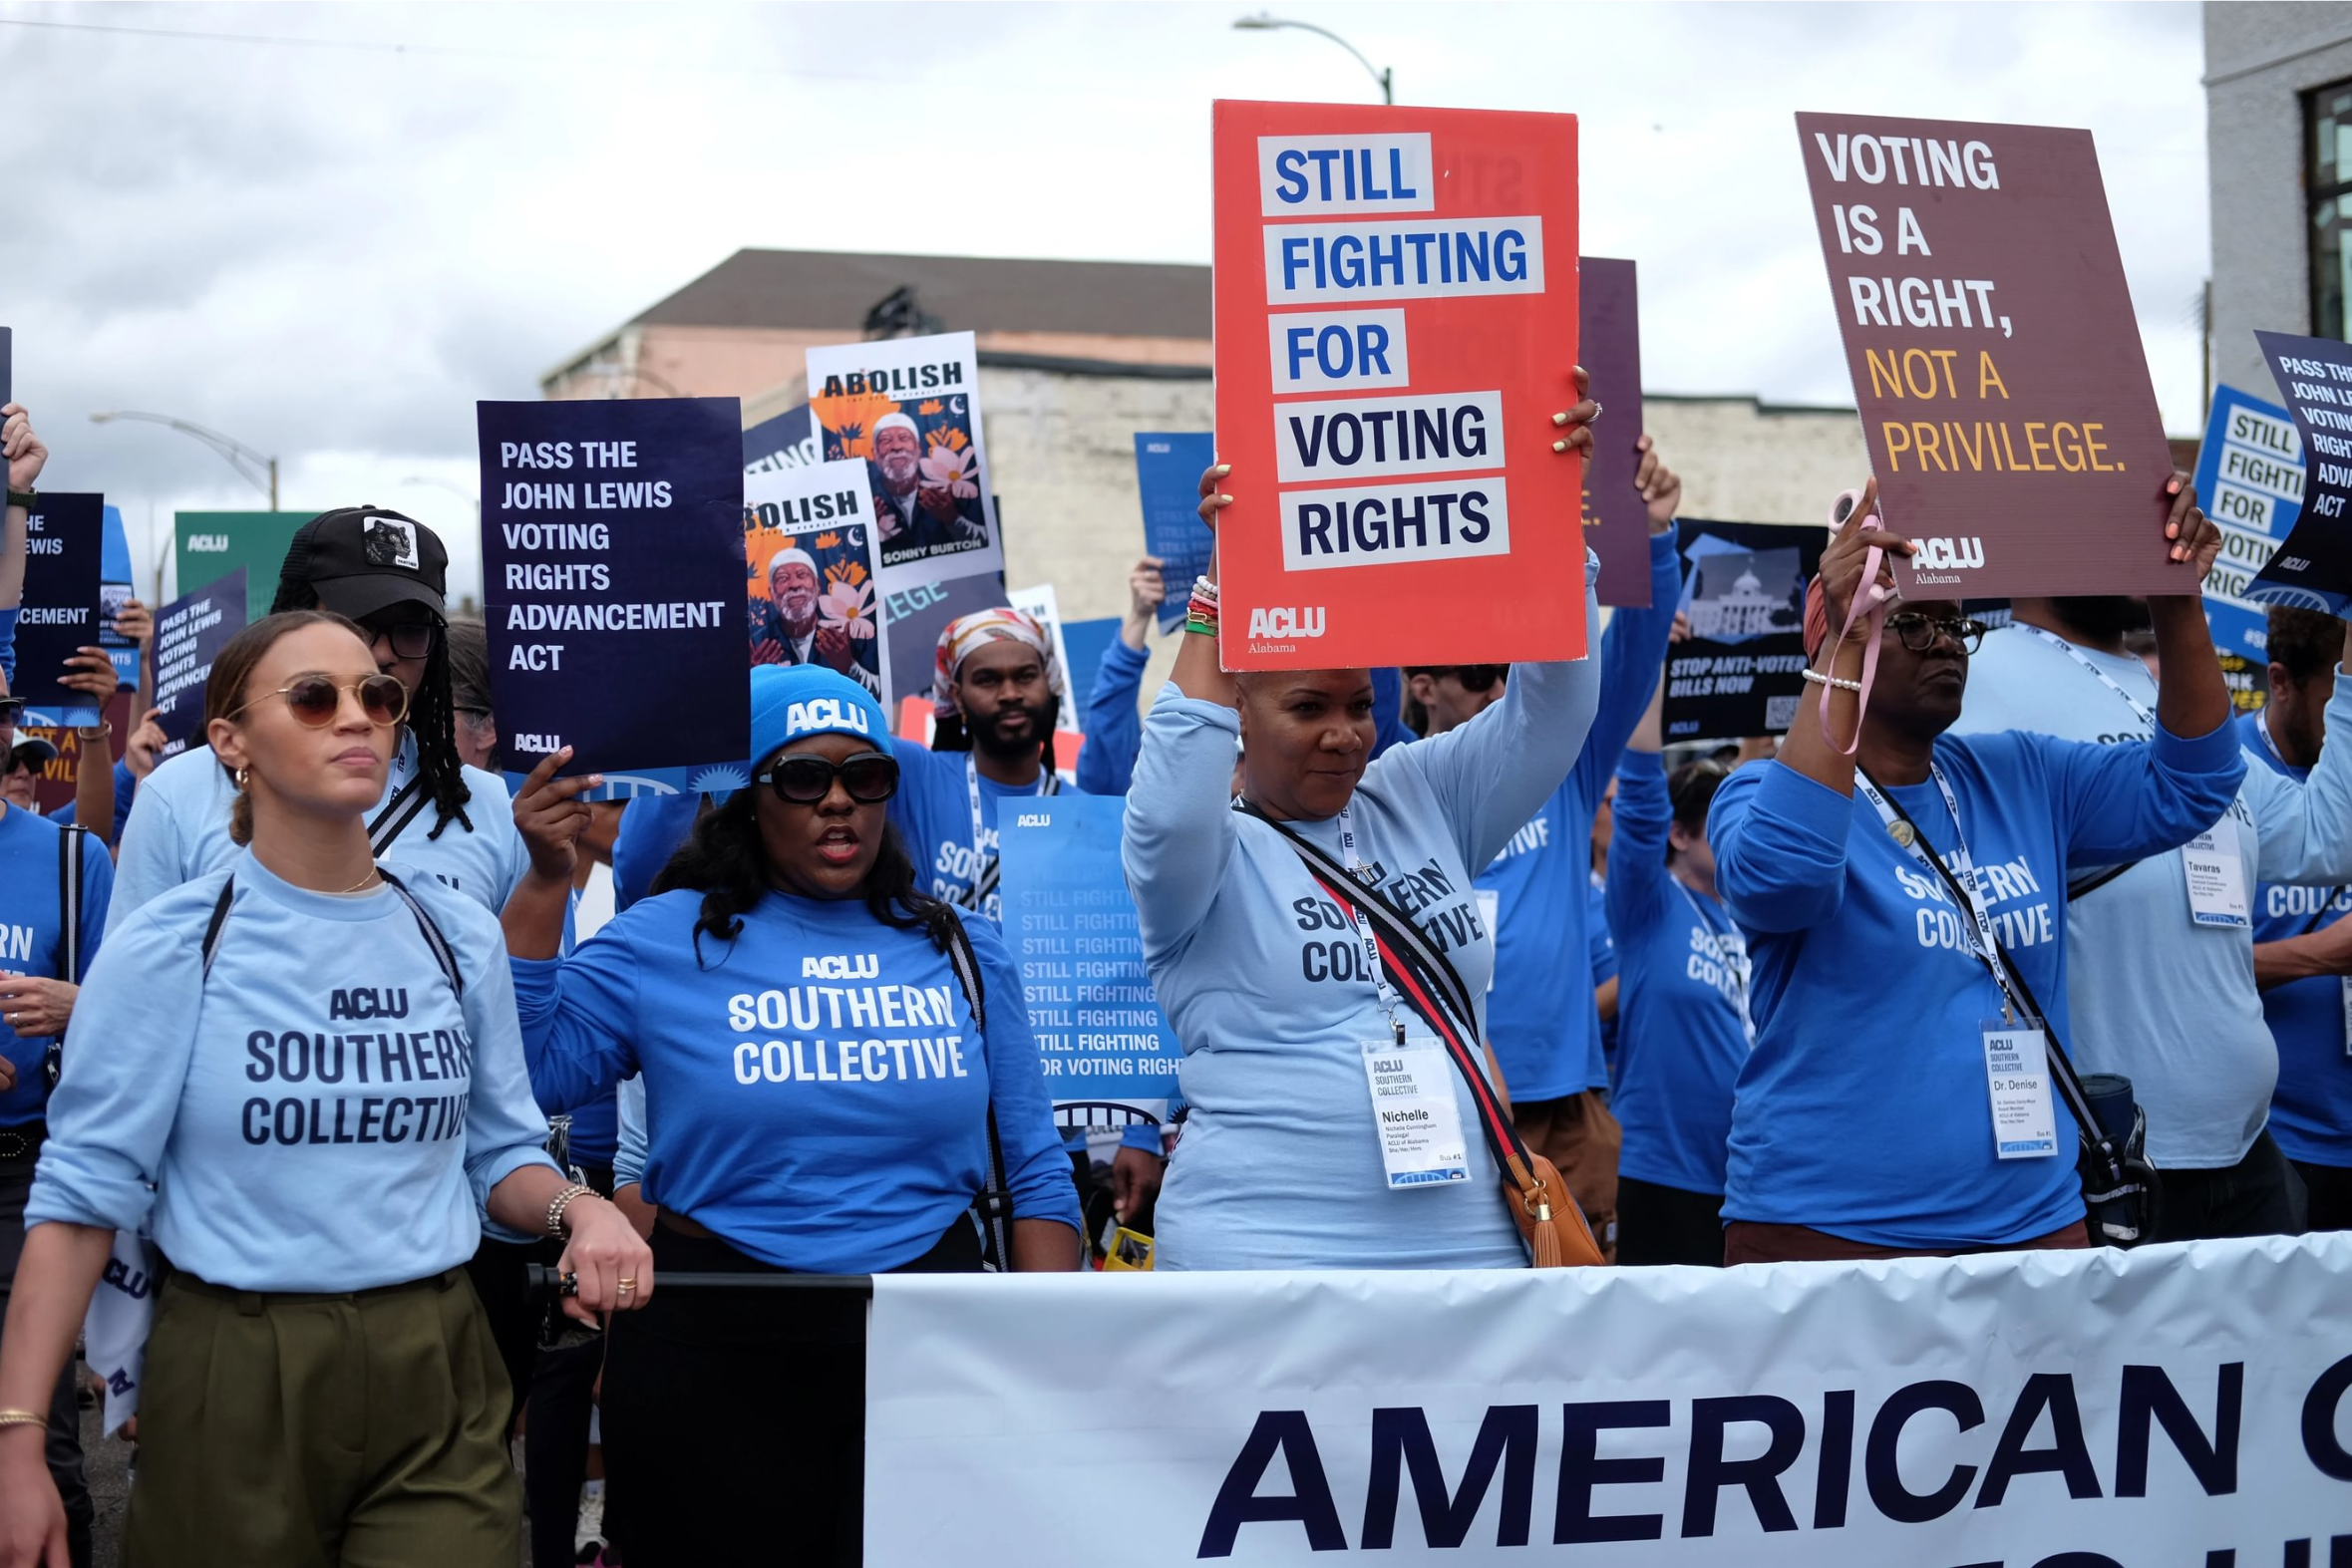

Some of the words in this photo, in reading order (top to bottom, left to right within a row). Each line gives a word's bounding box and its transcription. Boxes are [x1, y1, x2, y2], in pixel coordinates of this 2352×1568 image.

[1816, 132, 2000, 190] VOTING
[1275, 148, 1417, 203] STILL
[1833, 203, 1883, 255] IS
[1897, 207, 1932, 256] A
[1282, 229, 1527, 290] FIGHTING
[1848, 276, 2012, 338] RIGHT,
[1287, 324, 1392, 380] FOR
[824, 362, 963, 399] ABOLISH
[1864, 347, 1958, 400] NOT
[1978, 351, 2010, 400] A
[2278, 356, 2327, 379] PASS
[2291, 381, 2337, 404] JOHN
[1289, 405, 1488, 468] VOTING
[1882, 421, 2126, 472] PRIVILEGE.
[2234, 414, 2292, 454] STILL
[2312, 433, 2352, 459] RIGH
[501, 442, 573, 469] PASS
[580, 441, 637, 468] THE
[743, 436, 816, 474] TING
[2227, 452, 2305, 496] FIGHTI
[502, 481, 575, 509] JOHN
[584, 480, 673, 509] LEWIS
[2219, 490, 2266, 524] FOR
[2313, 492, 2346, 518] ACT
[26, 514, 45, 531] HE
[744, 490, 858, 531] BOLISH
[1298, 490, 1491, 555] RIGHTS
[25, 538, 63, 554] EWIS
[187, 534, 229, 552] ACLU
[502, 522, 610, 550] VOTING
[882, 545, 927, 565] SONNY
[929, 539, 982, 555] BURTON
[1910, 536, 1986, 570] ACLU
[2278, 555, 2310, 571] ACLU
[505, 563, 610, 590] RIGHTS
[1915, 573, 1961, 585] Alabama
[2206, 567, 2248, 598] RIG
[18, 607, 90, 624] CEMENT
[160, 608, 188, 634] PASS
[188, 597, 211, 619] THE
[506, 601, 726, 631] ADVANCEMENT
[1248, 606, 1326, 639] ACLU
[159, 625, 188, 652] JOHN
[187, 609, 222, 635] LEWIS
[158, 636, 197, 667] VOTING
[508, 644, 564, 671] ACT
[1248, 642, 1296, 654] Alabama
[158, 653, 196, 684] RIGHTS
[1670, 657, 1712, 678] STOP
[1712, 655, 1809, 676] ANTI-VOTER
[157, 663, 213, 701] ADVANCE
[1669, 677, 1714, 698] BILLS
[1715, 675, 1755, 695] NOW
[786, 698, 869, 738] ACLU
[61, 730, 77, 754] A
[514, 733, 560, 754] ACLU
[1865, 787, 1883, 805] ACLU
[1017, 813, 1051, 827] ACLU
[1343, 831, 1354, 848] ACLU
[2187, 861, 2221, 874] Tavaras
[1964, 870, 1977, 892] ACLU
[1074, 890, 1131, 906] FIGHTI
[1021, 913, 1069, 931] STILL
[1074, 913, 1140, 930] FIGHTIN
[1977, 911, 1990, 933] ACLU
[1022, 937, 1070, 955] STILL
[1075, 937, 1144, 954] FIGHTIN
[1364, 938, 1378, 961] ACLU
[802, 954, 880, 980] ACLU
[1023, 961, 1072, 979] STILL
[1076, 961, 1148, 979] FIGHTIN
[329, 987, 409, 1021] ACLU
[1024, 985, 1073, 1003] STILL
[1077, 985, 1157, 1003] FIGHTING
[728, 985, 957, 1033] SOUTHERN
[1028, 1010, 1073, 1027] STILL
[1077, 1010, 1159, 1027] FIGHTING
[1035, 1034, 1074, 1052] TILL
[1078, 1034, 1160, 1052] FIGHTING
[1990, 1039, 2013, 1052] ACLU
[245, 1029, 474, 1085] SOUTHERN
[733, 1036, 968, 1086] COLLECTIVE
[1041, 1058, 1063, 1076] OR
[1068, 1058, 1134, 1076] VOTING
[1138, 1058, 1184, 1076] RIGH
[1374, 1059, 1404, 1074] ACLU
[1990, 1053, 2020, 1063] SOUTHERN
[1991, 1063, 2023, 1073] COLLECTIVE
[1375, 1074, 1413, 1086] SOUTHERN
[1377, 1085, 1419, 1097] COLLECTIVE
[1994, 1081, 2006, 1091] Dr.
[2008, 1079, 2038, 1090] Denise
[1382, 1109, 1429, 1123] Nichelle
[101, 1257, 151, 1300] CLU
[1196, 1361, 2244, 1560] AMERICAN
